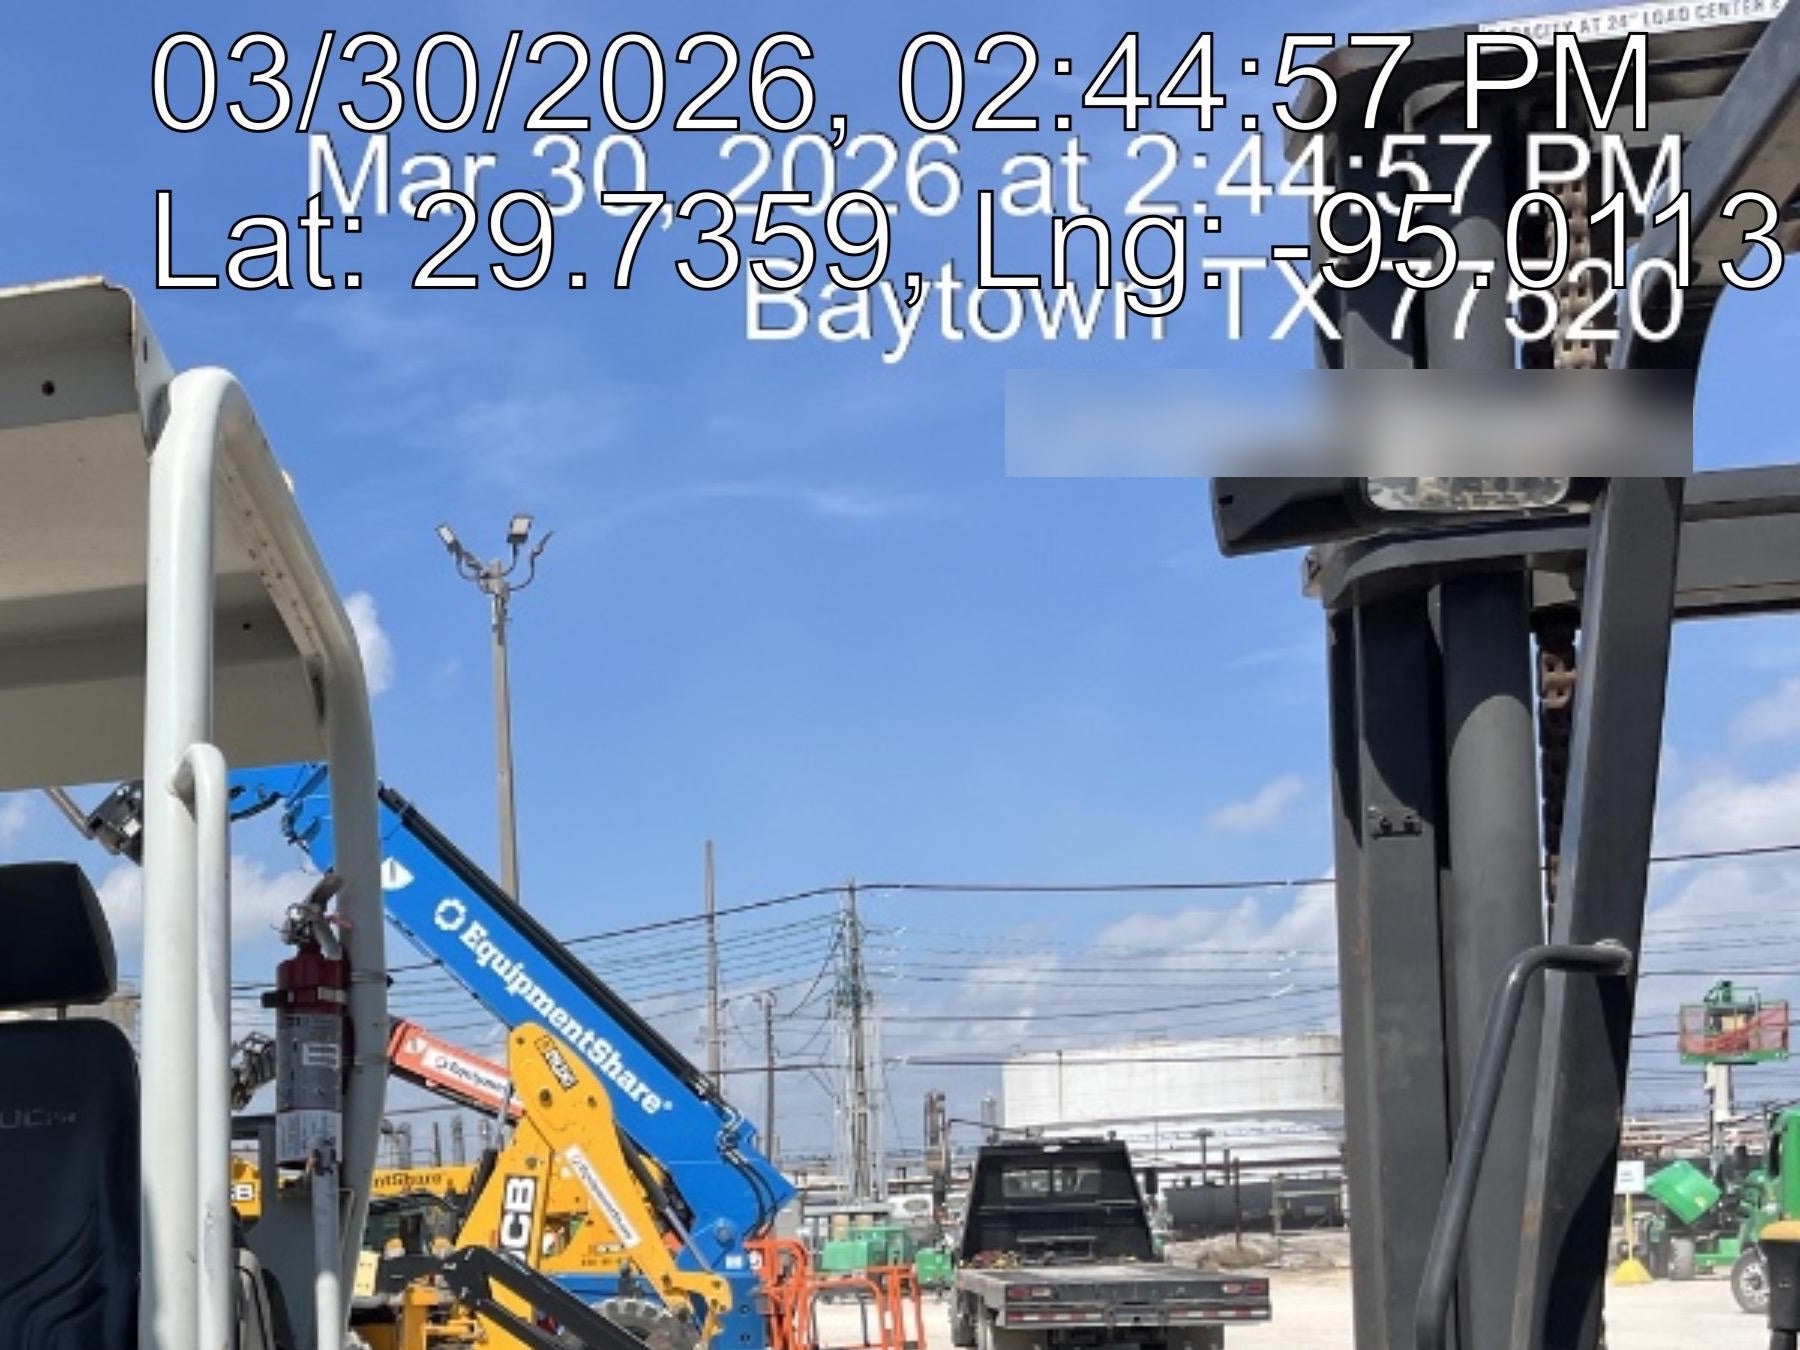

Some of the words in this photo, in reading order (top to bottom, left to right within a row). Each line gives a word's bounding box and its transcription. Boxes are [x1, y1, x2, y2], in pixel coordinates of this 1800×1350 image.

[1486, 19, 1574, 42] ACITY
[459, 920, 663, 1115] EquipmentShare
[500, 1177, 536, 1262] CB
